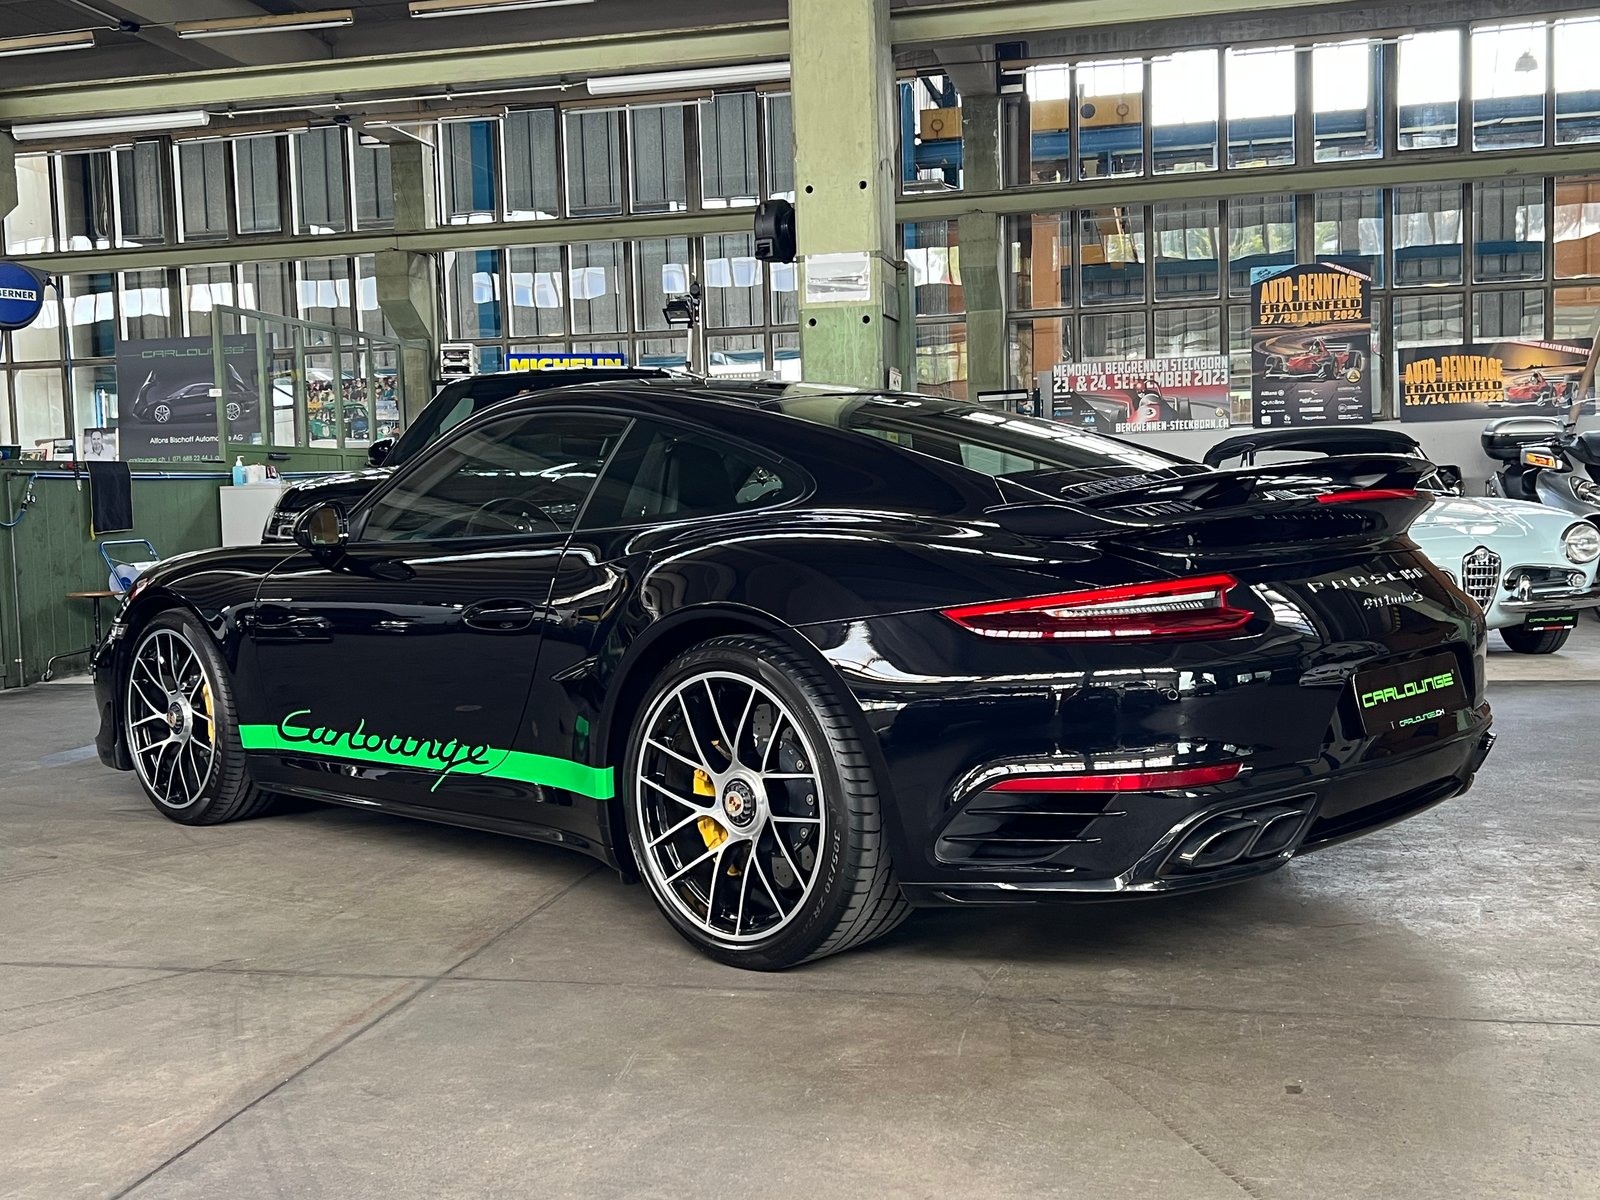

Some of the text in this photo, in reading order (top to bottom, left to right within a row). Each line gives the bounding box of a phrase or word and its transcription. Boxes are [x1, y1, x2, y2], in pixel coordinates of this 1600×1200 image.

[0, 289, 34, 299] ERNER
[1261, 273, 1362, 304] AUTO-RENNTAGE
[1261, 299, 1362, 314] FRAUENFELD
[1333, 309, 1362, 321] 2024
[141, 346, 245, 358] CARLOUGE
[509, 358, 622, 371] MICHELIN
[1053, 356, 1229, 378] MEMORIAL BERGRENNEN STECKBORN
[1405, 355, 1503, 384] AUTO-RENNTAGE
[1053, 377, 1074, 393] 23.
[1076, 376, 1088, 391] &
[1090, 375, 1112, 391] 24.
[1194, 368, 1229, 386] 2023
[1406, 381, 1503, 394] FRAUENFELD
[1474, 391, 1503, 403] 2023
[1115, 418, 1230, 433] BERGRENNEN-STECKBORN.CH
[170, 435, 194, 443] Bischoff
[1307, 567, 1428, 593] PORSCHE
[1361, 672, 1454, 708] CARLOUNGE
[1399, 708, 1446, 728] CARLOUNGE.CH
[277, 709, 490, 793] Carlounge
[825, 829, 841, 894] 305/30
